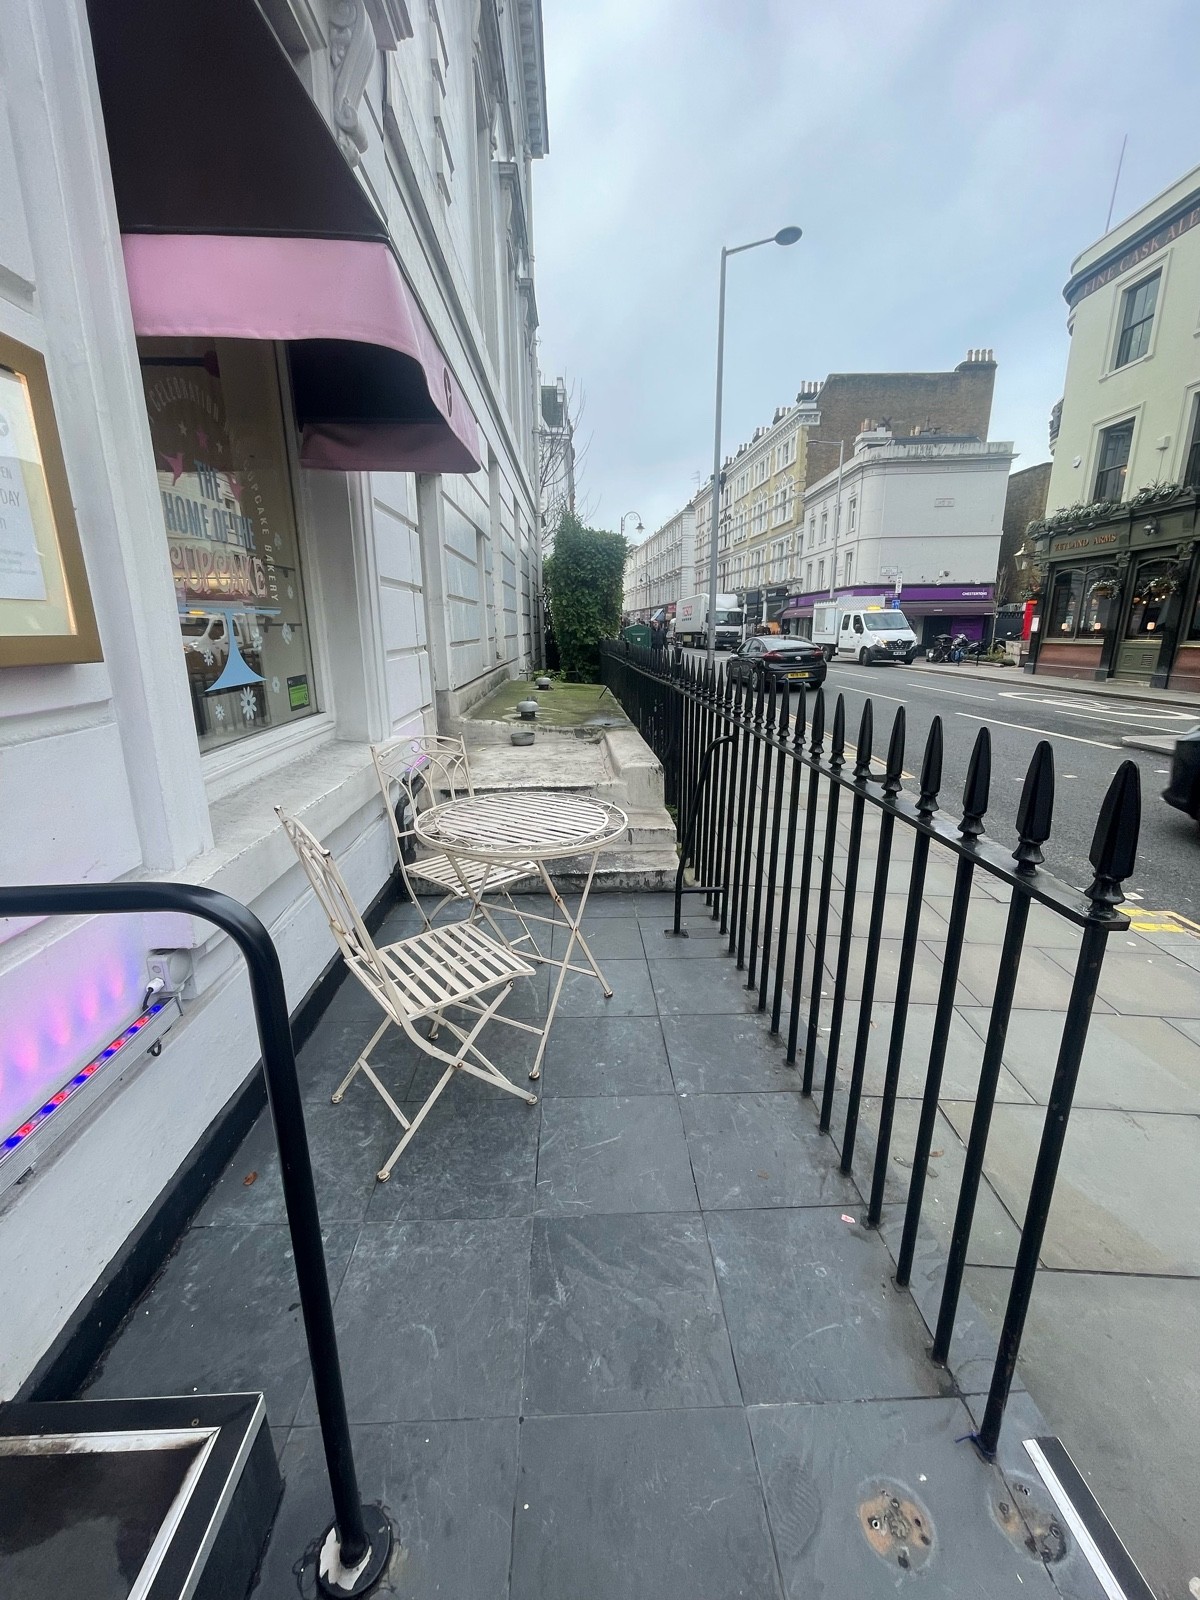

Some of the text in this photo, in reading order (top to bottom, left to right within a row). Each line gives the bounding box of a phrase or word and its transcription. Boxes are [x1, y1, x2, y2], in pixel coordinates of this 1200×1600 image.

[1084, 265, 1116, 295] FINE
[1120, 235, 1160, 273] CASK
[194, 459, 223, 504] THE
[162, 490, 256, 550] HOME OF THE
[1094, 533, 1117, 545] ARMS
[169, 544, 268, 598] CUPCAKE
[264, 544, 279, 601] BAKERY
